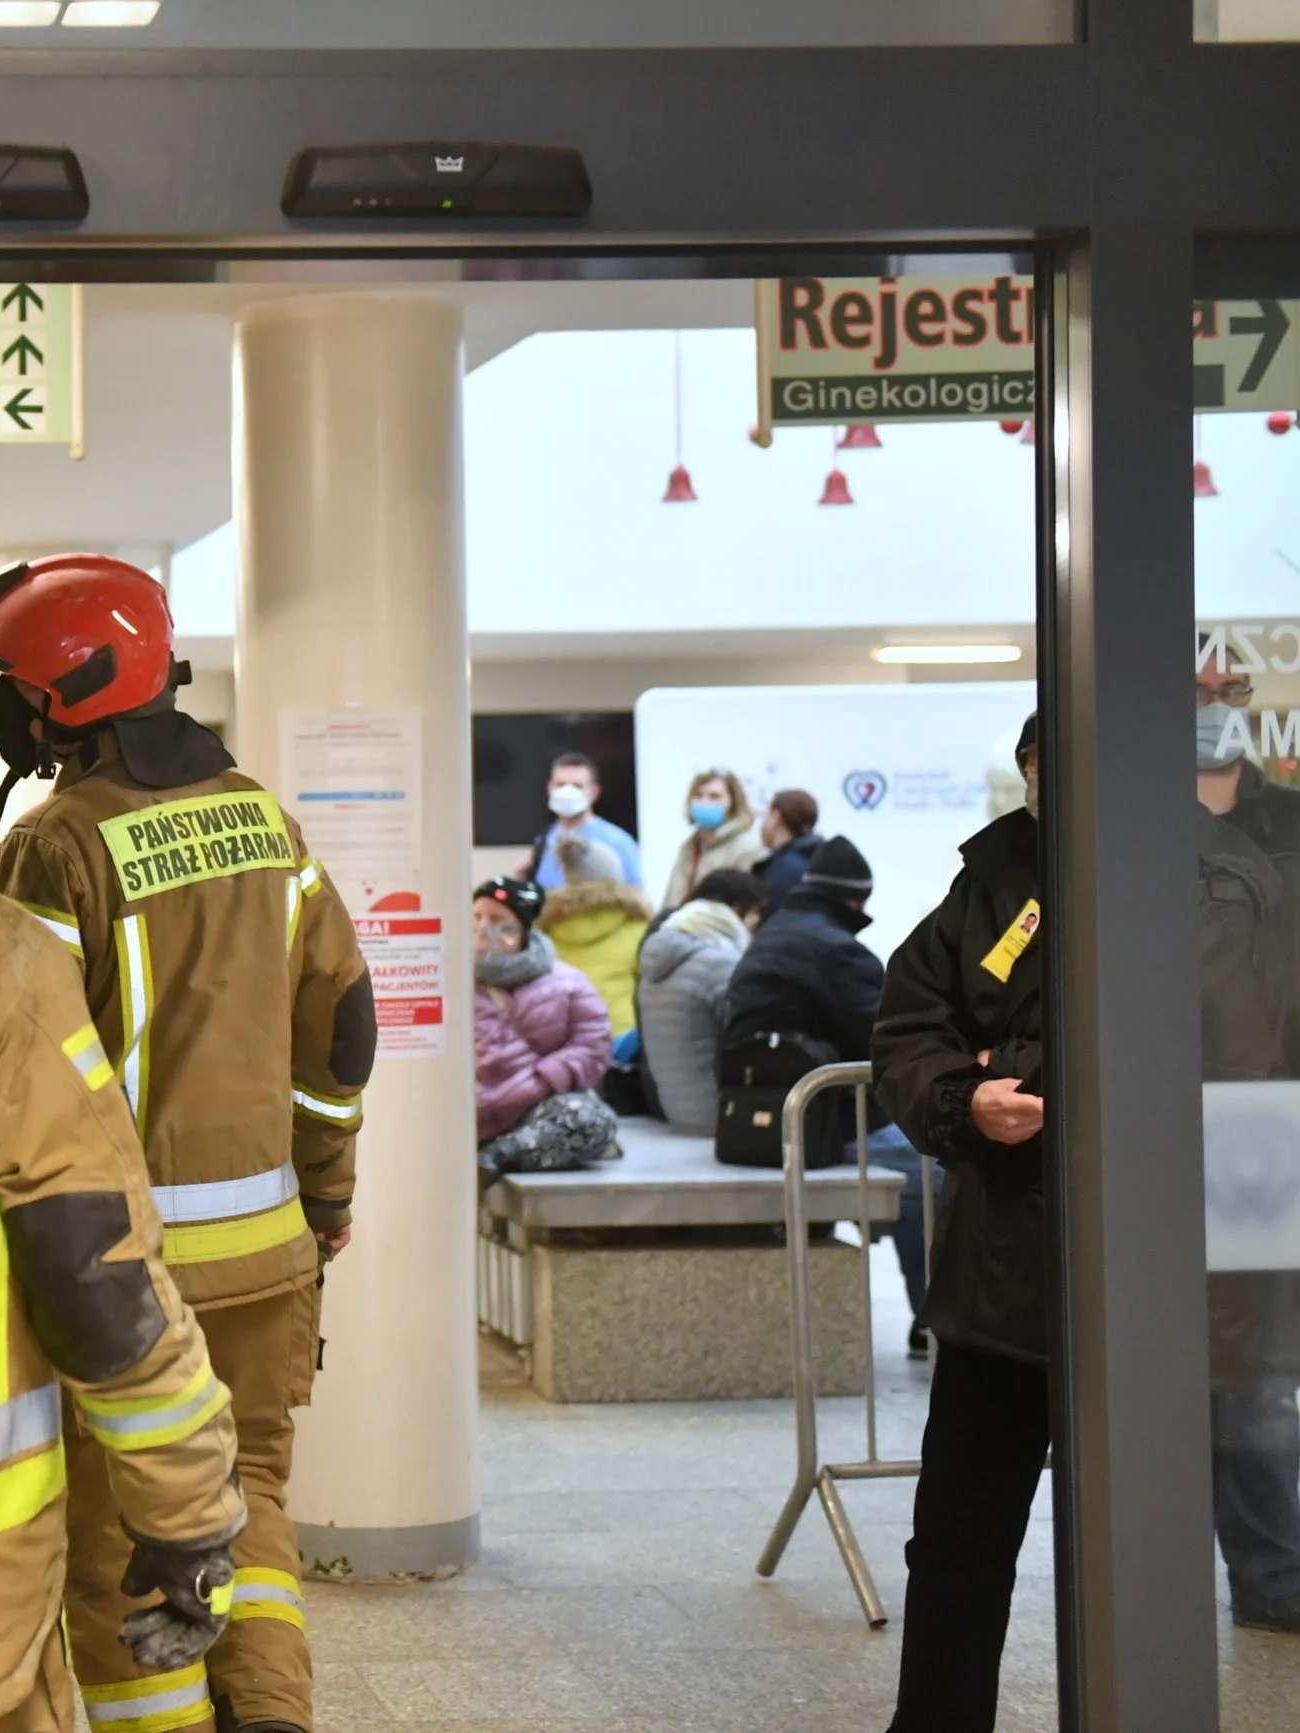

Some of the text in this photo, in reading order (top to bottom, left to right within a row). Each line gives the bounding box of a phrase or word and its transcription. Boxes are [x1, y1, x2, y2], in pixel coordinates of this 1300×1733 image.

[778, 276, 1034, 371] Rejest
[126, 801, 269, 852] PAŃSTWOWA
[122, 832, 292, 892] STRAŻ POŻARNA
